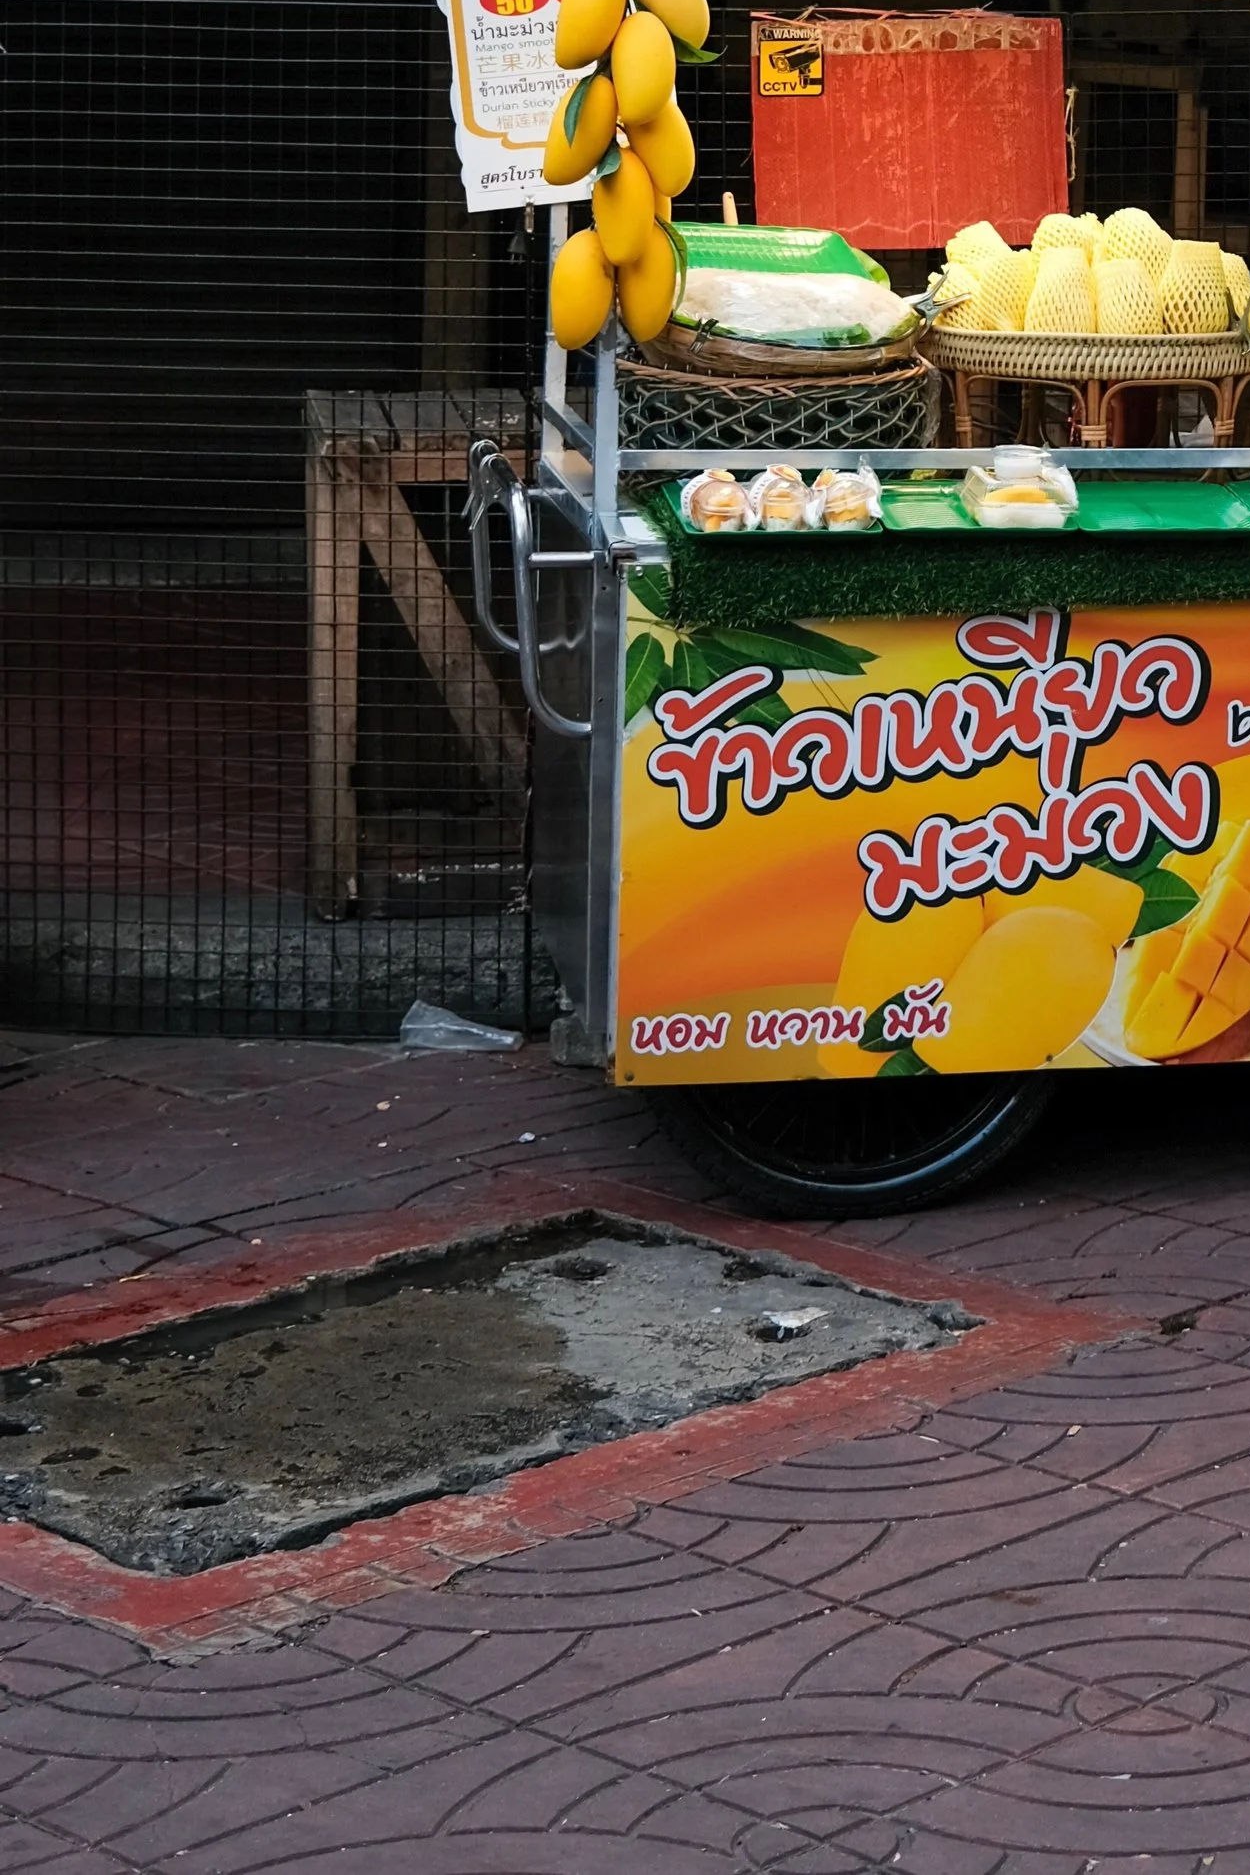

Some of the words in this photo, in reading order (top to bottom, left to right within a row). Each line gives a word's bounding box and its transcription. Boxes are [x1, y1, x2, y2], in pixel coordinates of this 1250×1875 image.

[471, 16, 557, 41] น้ำมะม่วง
[476, 42, 515, 53] Mango
[518, 37, 555, 49] smoot
[475, 50, 556, 75] 芒果冰
[479, 73, 580, 97] ข้าวเหนียวทุเรีย
[762, 82, 798, 92] CCTV
[481, 102, 519, 113] Durian
[522, 98, 556, 111] Sticky
[480, 165, 544, 189] สูตรโบรา
[648, 607, 1206, 822] ข้าวเหนียว
[861, 729, 1215, 916] มะม่วง
[632, 1012, 731, 1054] หอม
[747, 1005, 865, 1048] หวาน
[884, 979, 951, 1041] มัน
